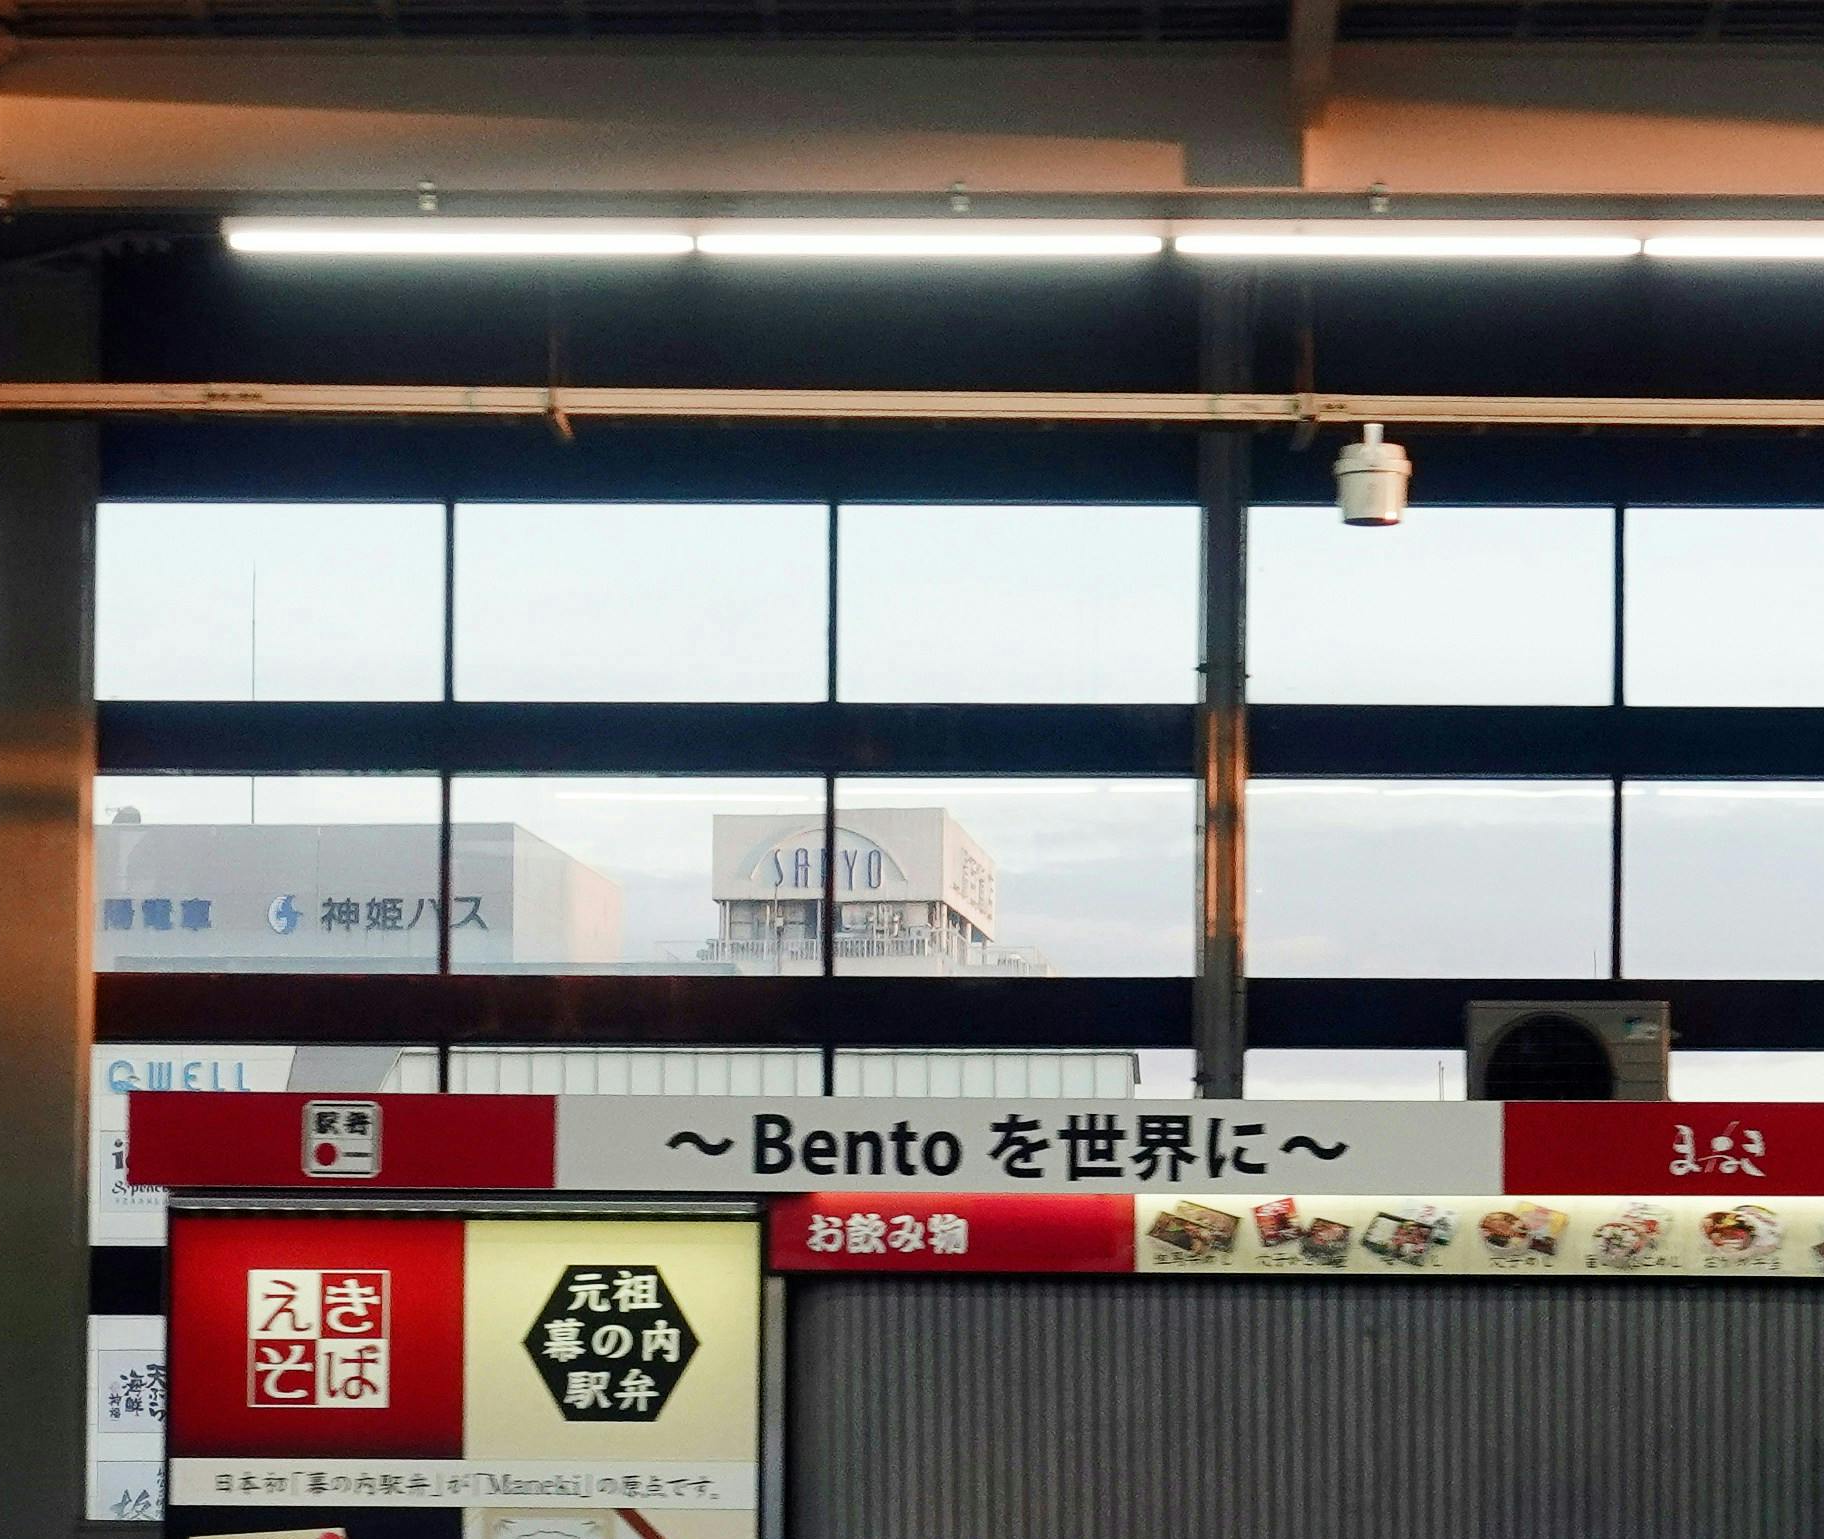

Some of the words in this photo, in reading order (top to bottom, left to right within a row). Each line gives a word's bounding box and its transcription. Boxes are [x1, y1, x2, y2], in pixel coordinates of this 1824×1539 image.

[773, 847, 883, 889] SAYO
[806, 1213, 969, 1255] お飲み物
[567, 1269, 662, 1313] 元祖
[543, 1321, 682, 1364] 幕の内
[563, 1370, 659, 1413] 駅弁
